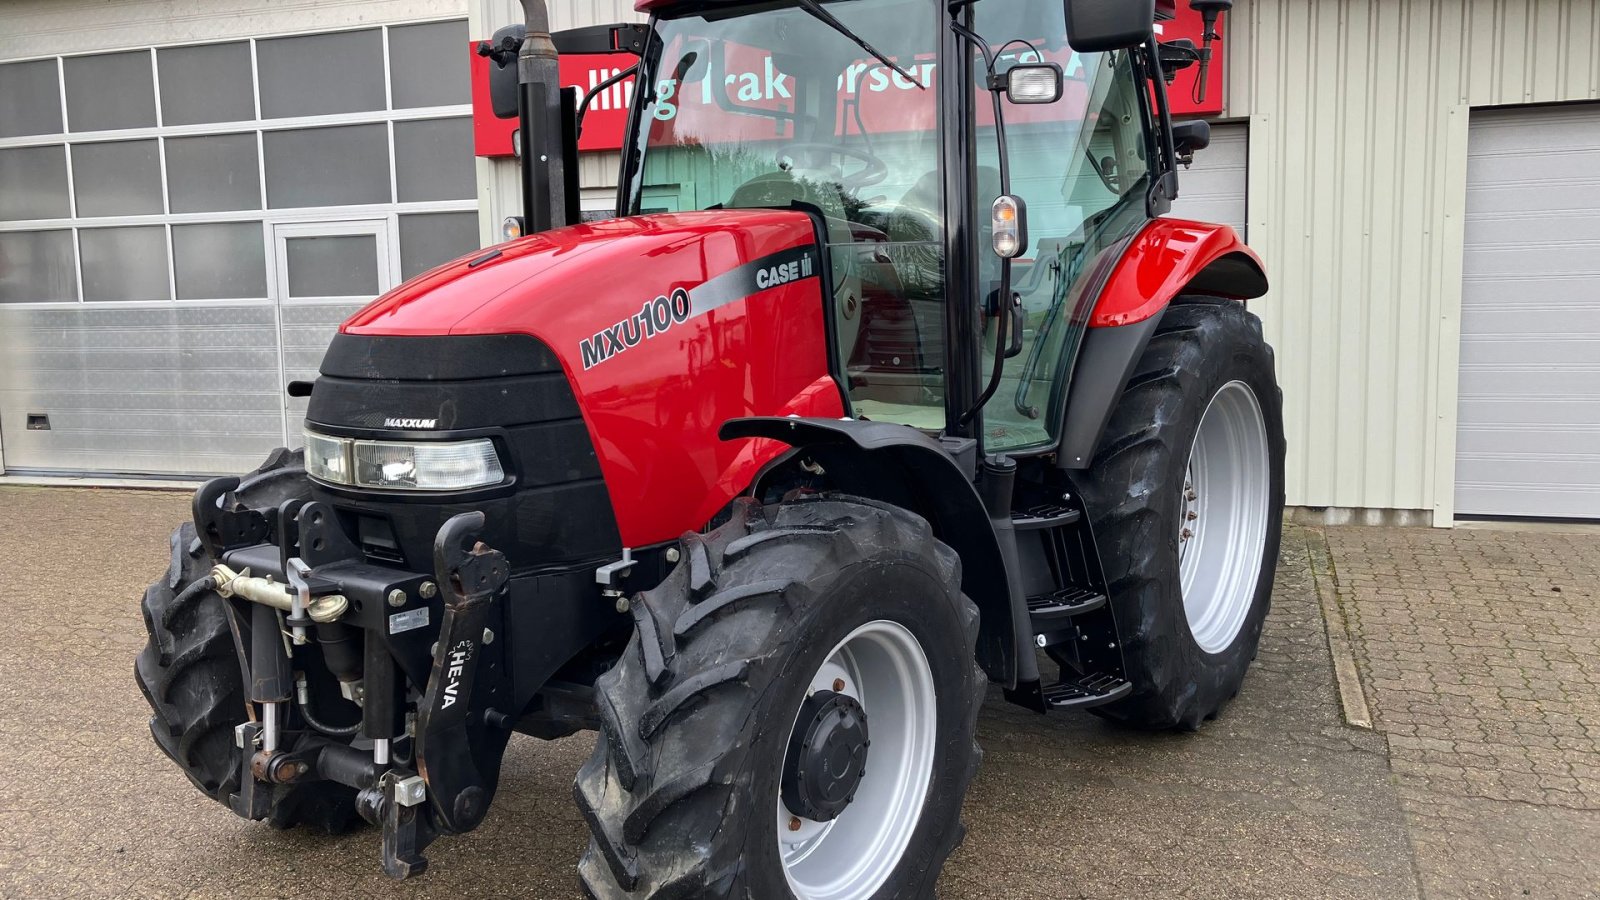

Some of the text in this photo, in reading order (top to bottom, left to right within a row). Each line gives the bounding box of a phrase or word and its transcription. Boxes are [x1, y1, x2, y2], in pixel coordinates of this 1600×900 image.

[756, 260, 799, 289] CASE
[579, 287, 692, 370] MXU100
[384, 418, 437, 428] MAXXUM
[441, 651, 466, 710] HE-VA
